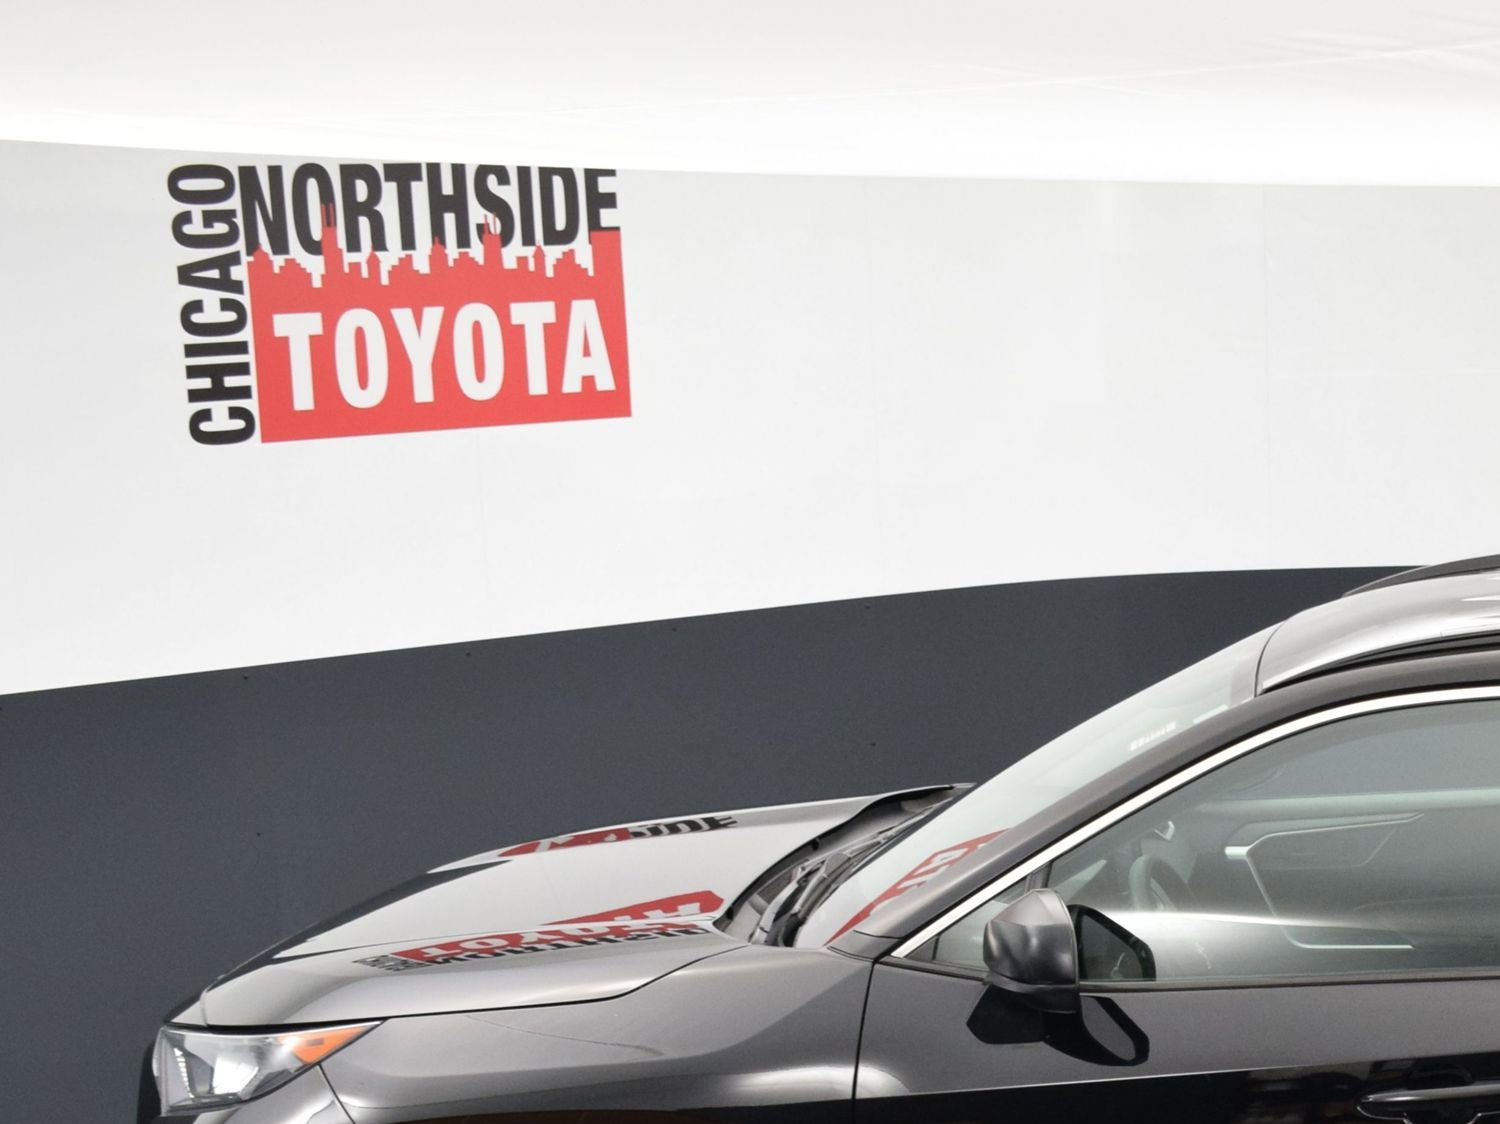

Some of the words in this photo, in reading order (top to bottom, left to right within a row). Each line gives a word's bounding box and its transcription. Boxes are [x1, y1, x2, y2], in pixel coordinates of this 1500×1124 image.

[237, 162, 622, 257] NORTHSIDE
[167, 163, 256, 446] CHICAGO
[272, 299, 616, 411] TOYOTA
